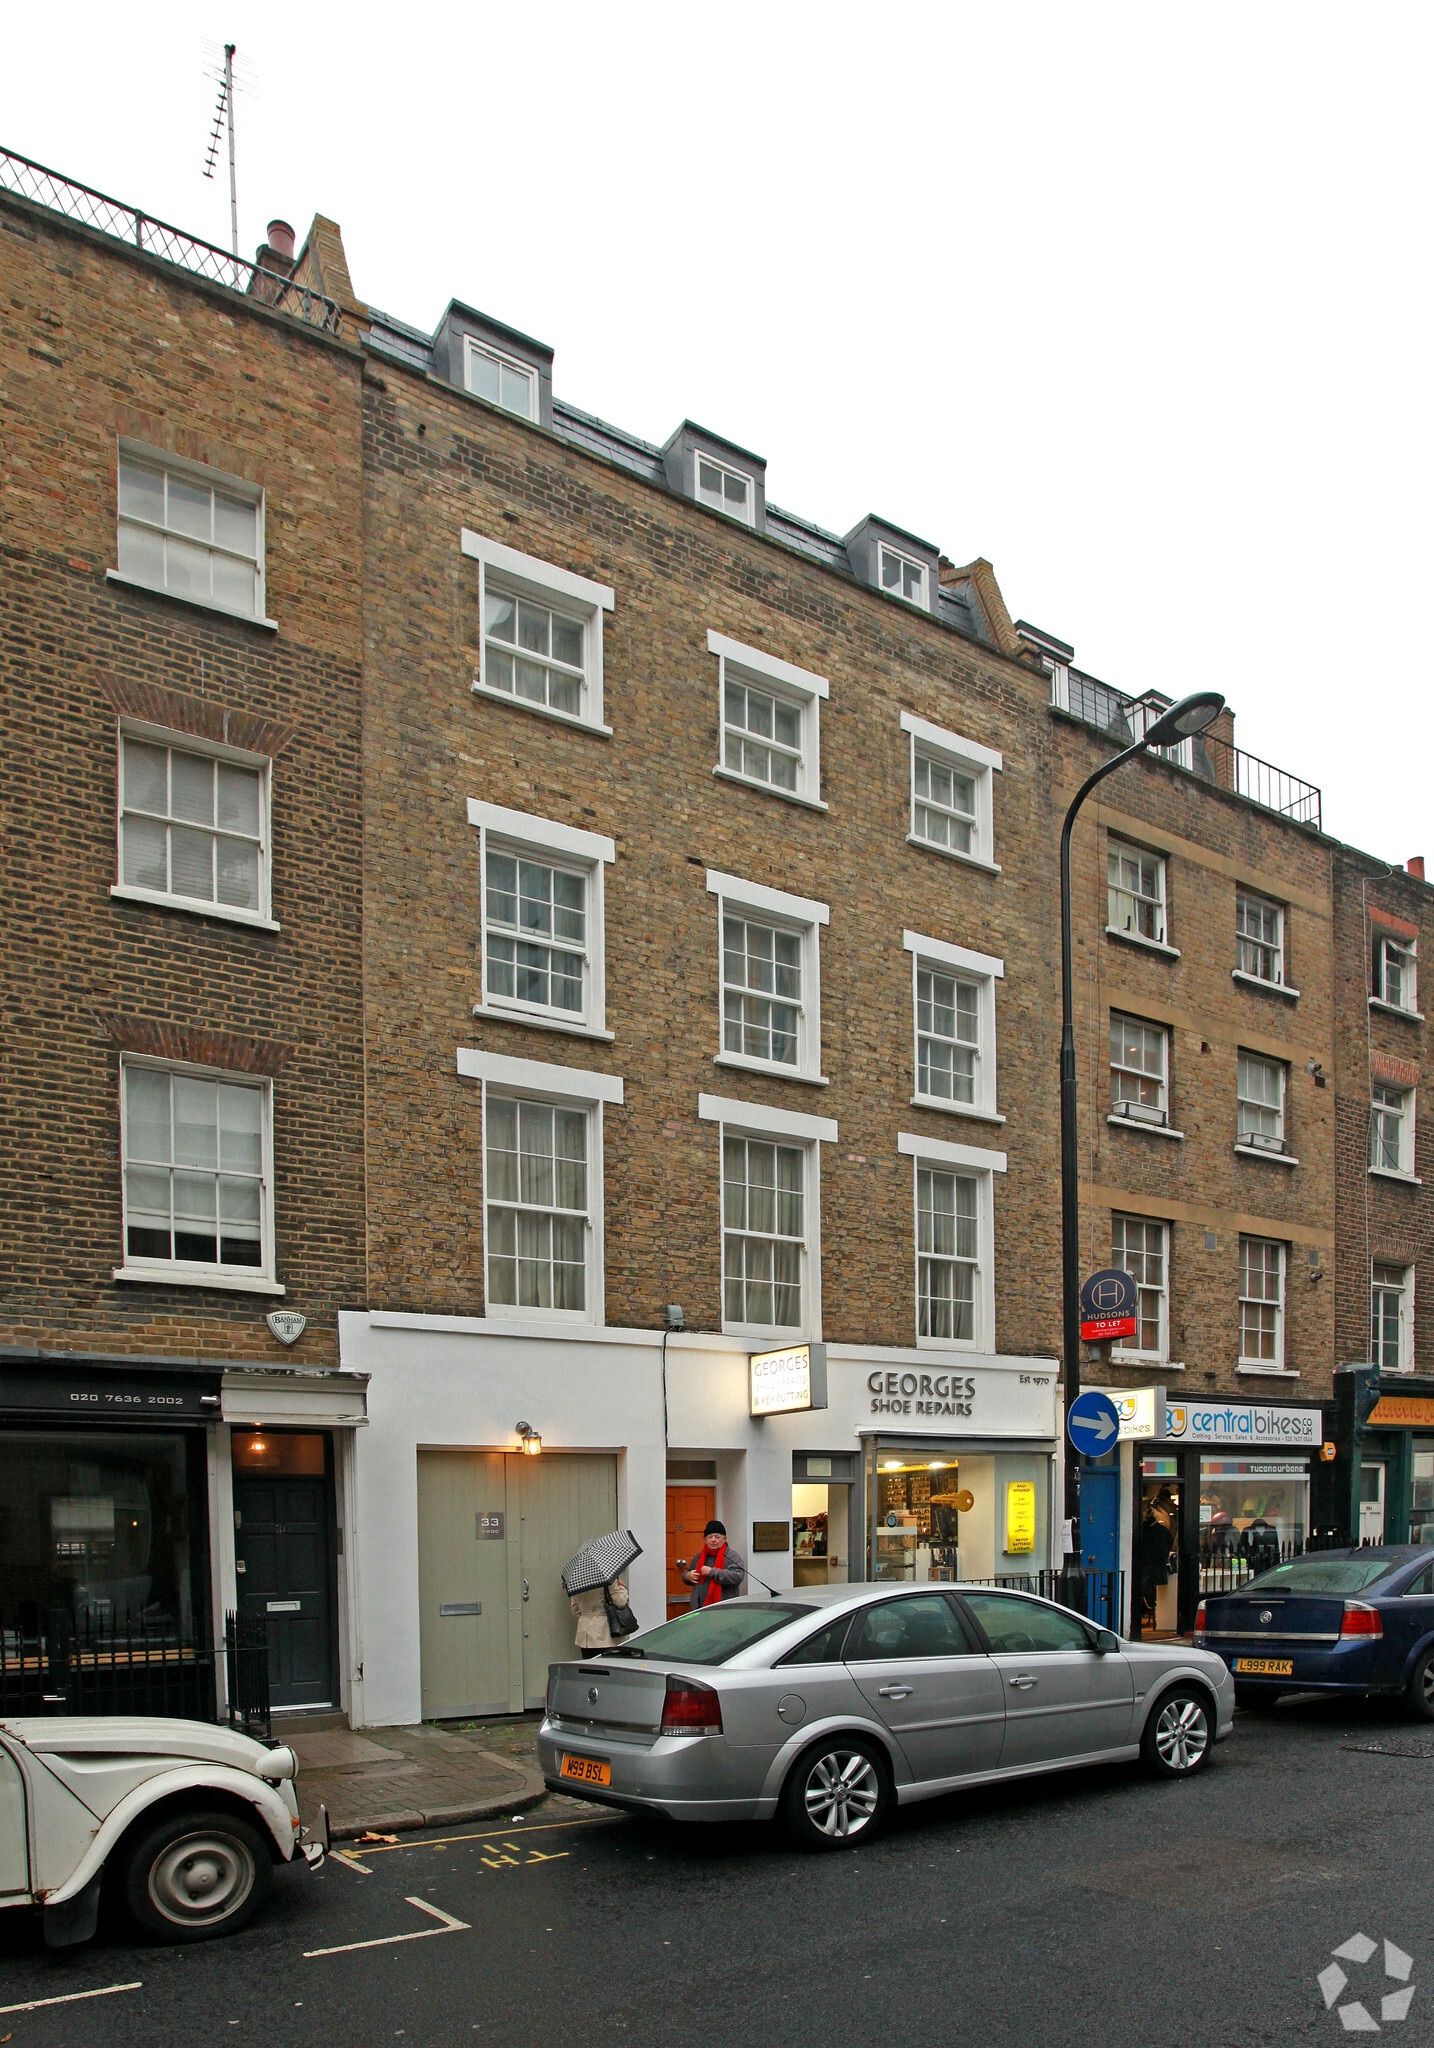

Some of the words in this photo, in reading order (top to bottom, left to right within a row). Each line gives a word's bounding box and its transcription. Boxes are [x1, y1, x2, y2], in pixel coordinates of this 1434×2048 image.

[1087, 1310, 1130, 1320] HUDSONS
[754, 1354, 808, 1377] GEORGES
[867, 1371, 976, 1399] GEORGES
[1019, 1374, 1031, 1384] Est
[1033, 1376, 1050, 1386] 1970
[70, 1393, 99, 1401] 020
[105, 1394, 142, 1403] 7636
[148, 1396, 184, 1405] 2002
[776, 1389, 809, 1402] CUTTING
[870, 1398, 912, 1414] SHOE
[915, 1400, 973, 1417] REPAIRS
[1192, 1408, 1301, 1434] centralbikes
[481, 1518, 499, 1526] 33
[1239, 1660, 1265, 1671] L999
[1268, 1661, 1289, 1672] RAK
[585, 1764, 604, 1781] BSL
